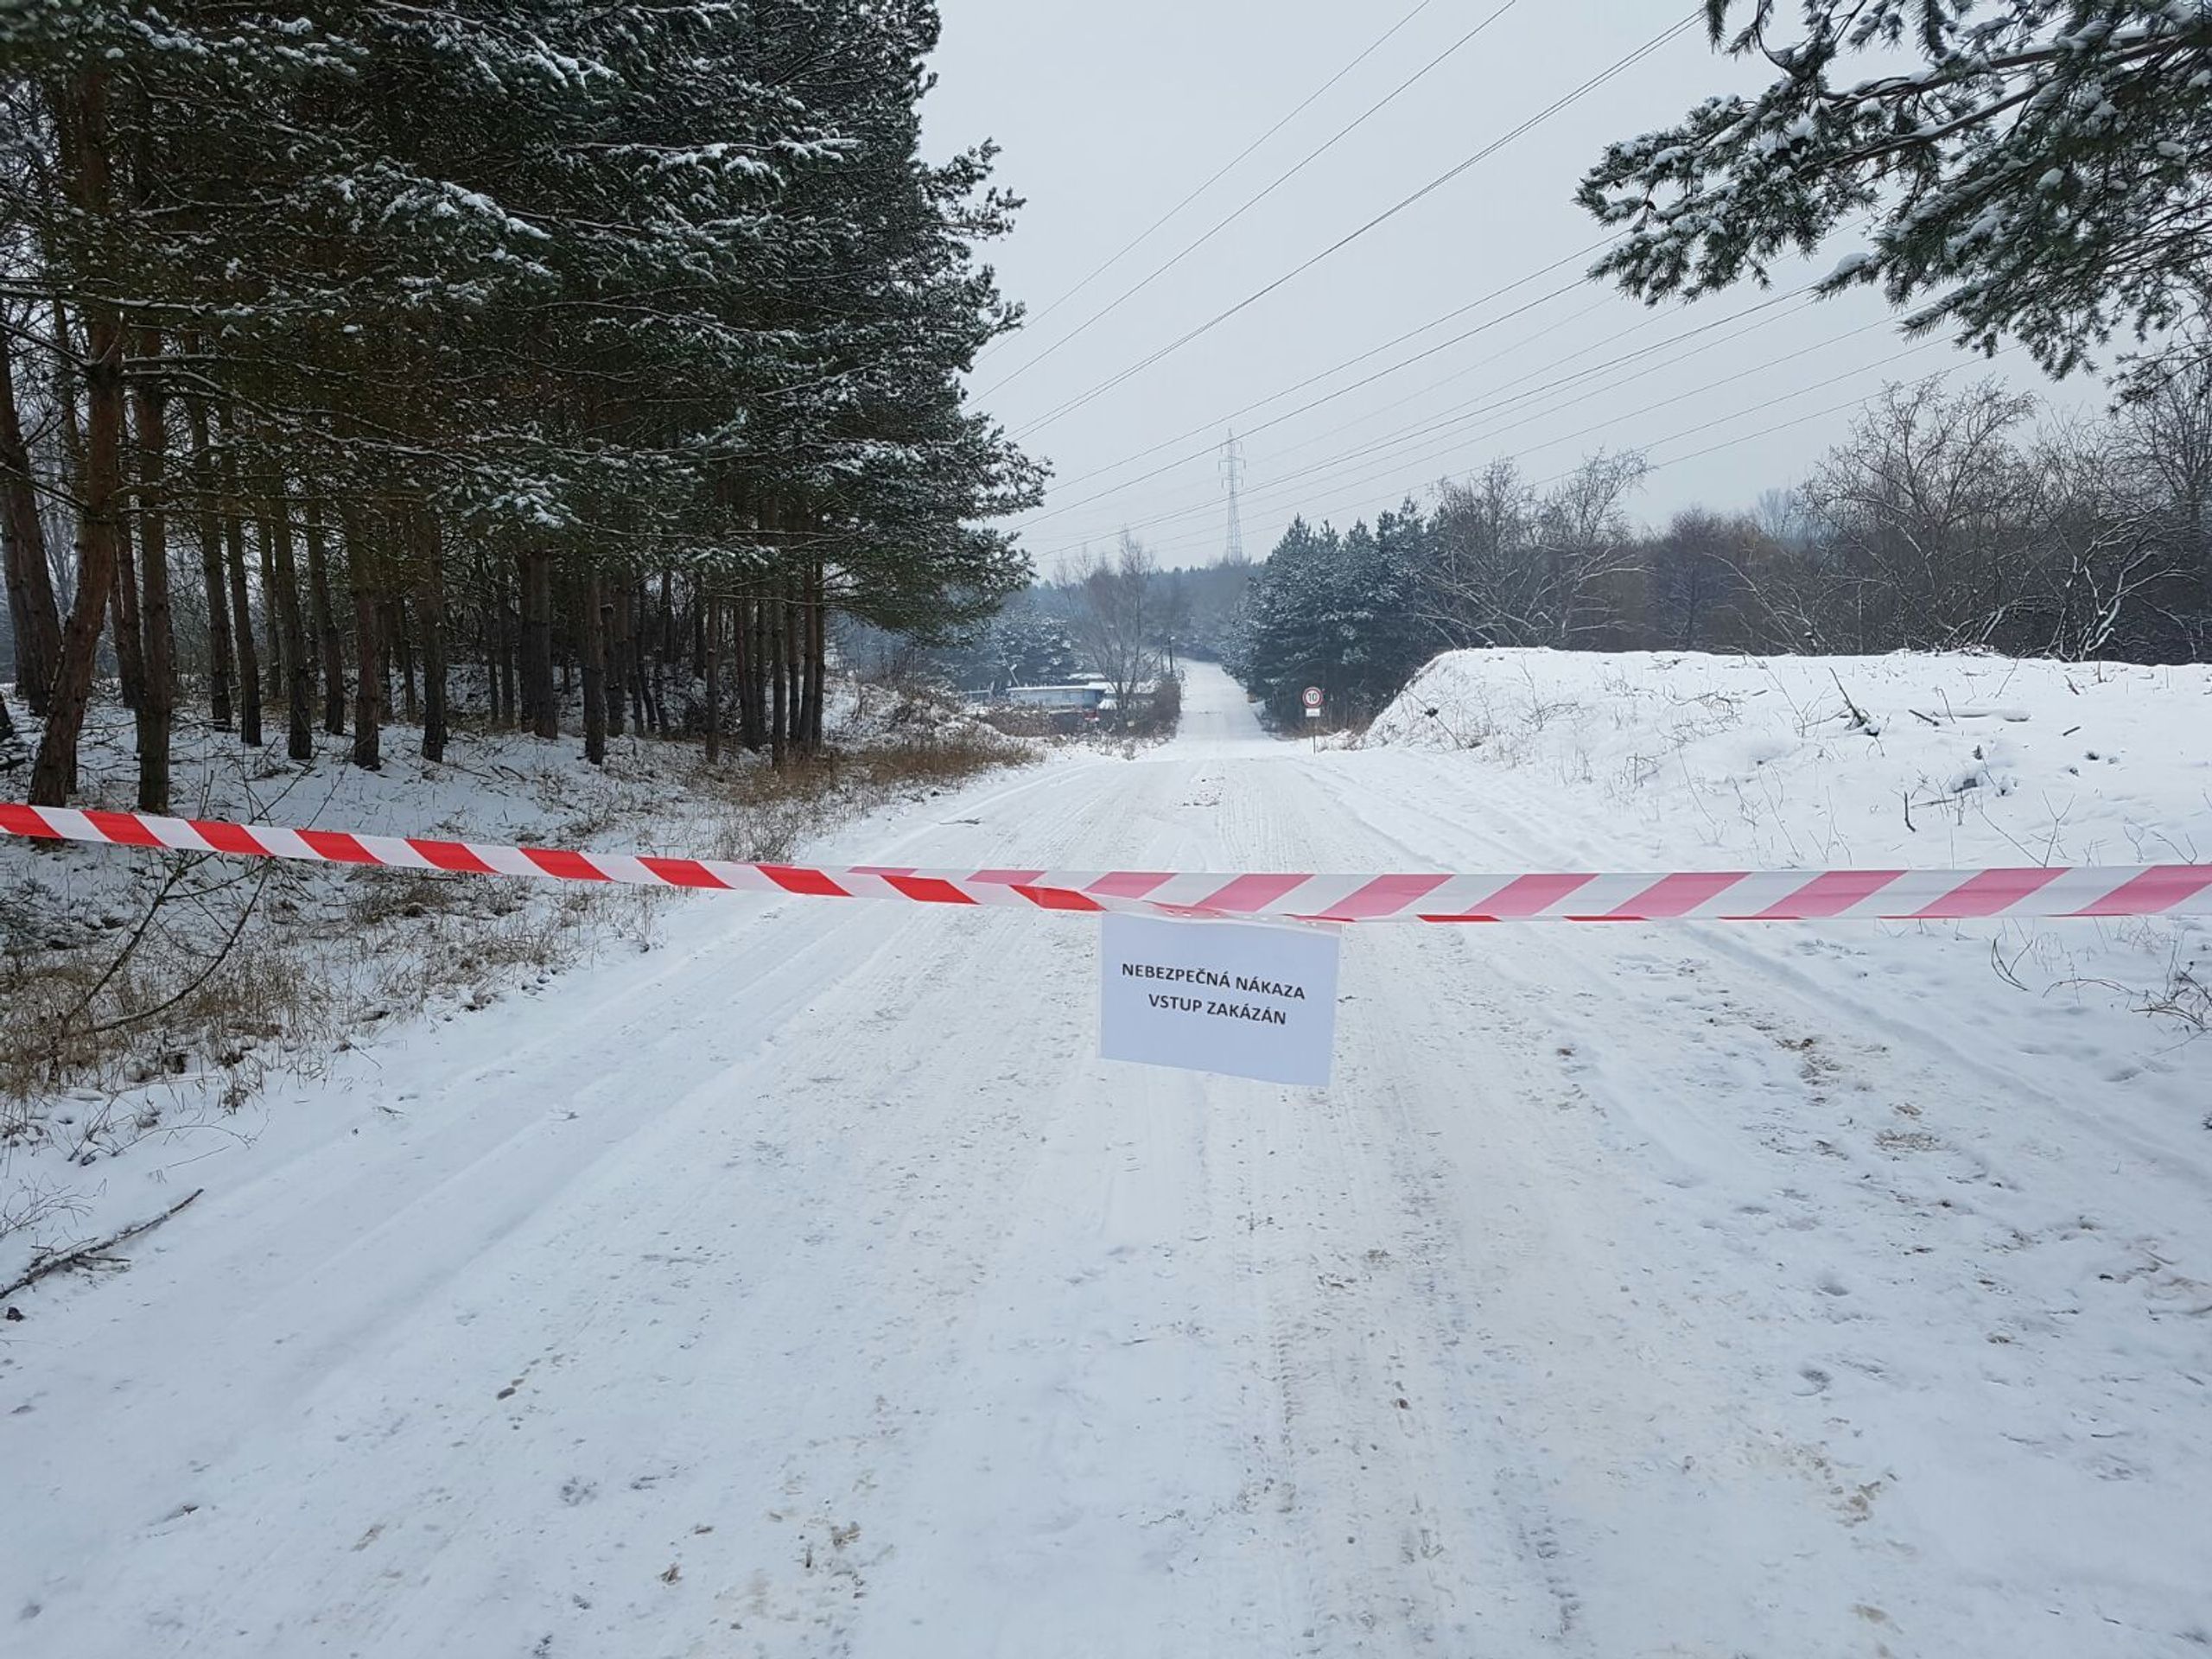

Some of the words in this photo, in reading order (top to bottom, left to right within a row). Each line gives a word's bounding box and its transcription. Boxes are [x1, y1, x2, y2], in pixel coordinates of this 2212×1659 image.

[1307, 692, 1318, 702] 10
[1122, 963, 1230, 988] NEBEZPEČNÁ
[1236, 976, 1306, 1000] NÁKAZA
[1148, 994, 1203, 1013] VSTUP
[1207, 1001, 1287, 1025] ZAKÁZÁN
